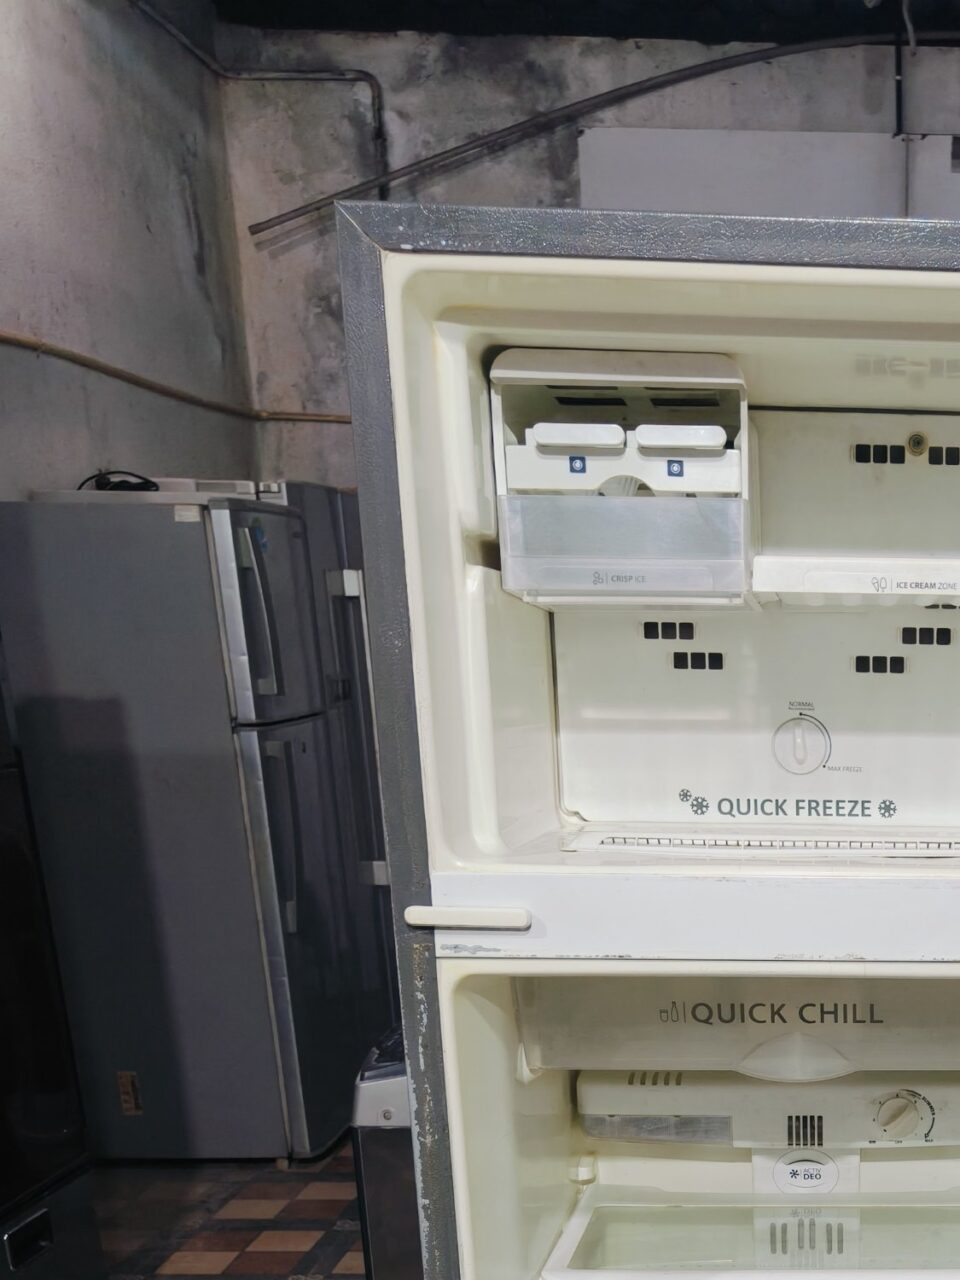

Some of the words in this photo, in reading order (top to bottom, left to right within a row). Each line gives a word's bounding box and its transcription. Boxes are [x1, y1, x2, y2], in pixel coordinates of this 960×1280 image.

[611, 574, 633, 583] CRISP
[635, 575, 648, 583] ICE
[896, 581, 908, 589] ICE
[938, 582, 958, 590] ZONE
[717, 798, 788, 818] QUICK
[795, 799, 872, 817] FREEZE
[691, 1002, 788, 1026] QUICK
[798, 1002, 884, 1024] CHILL
